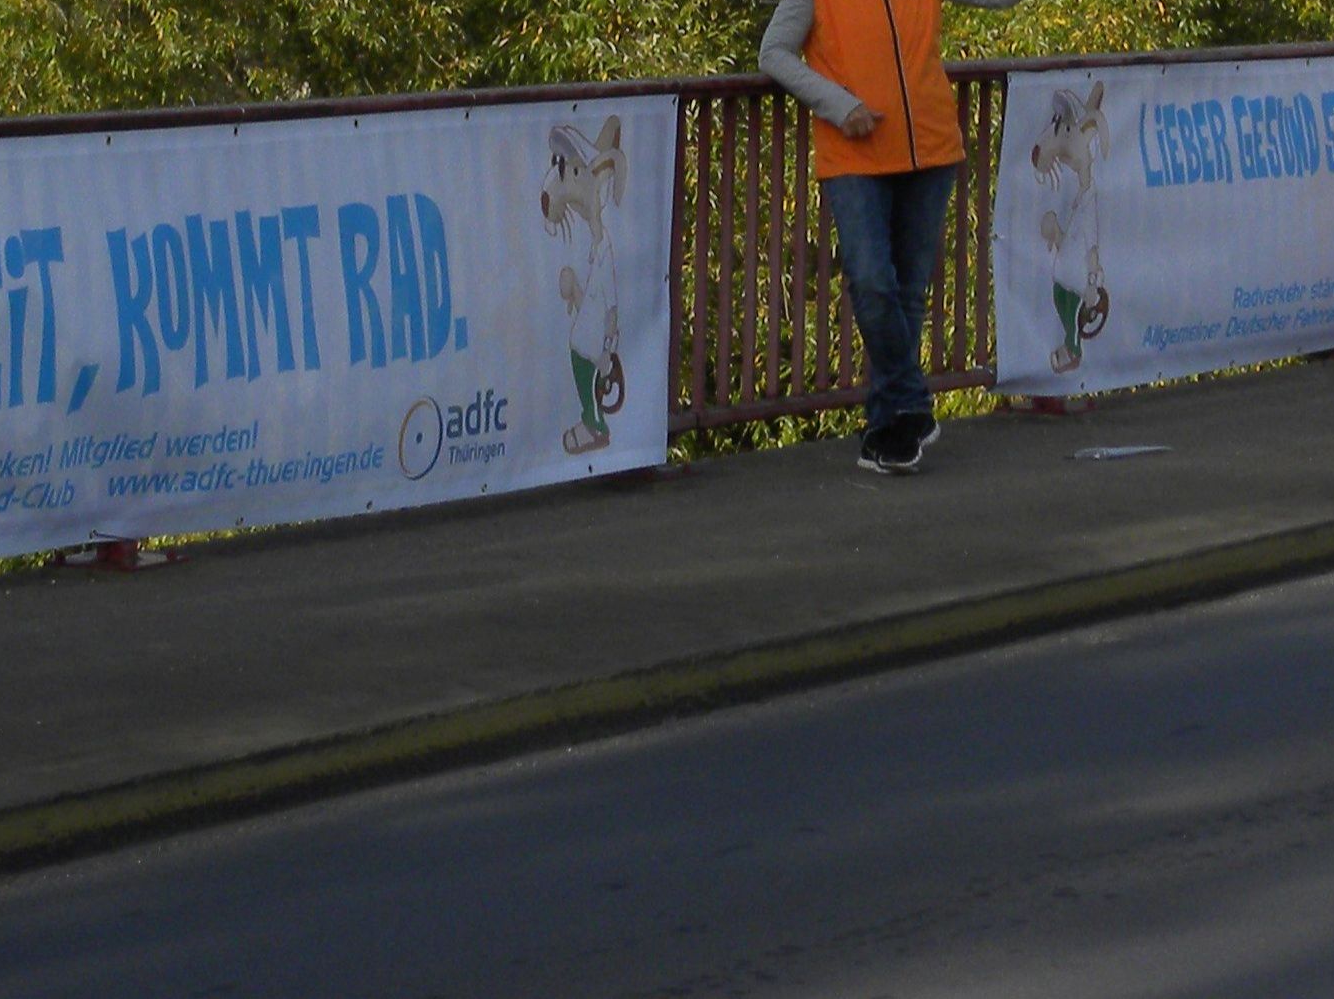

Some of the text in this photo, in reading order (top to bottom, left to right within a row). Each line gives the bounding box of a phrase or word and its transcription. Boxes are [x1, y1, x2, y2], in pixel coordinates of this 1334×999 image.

[1231, 93, 1321, 181] GESUND
[106, 204, 321, 398] KOMMT
[337, 192, 467, 369] RAD.
[446, 392, 509, 438] adfc
[60, 433, 158, 470] Mitglied
[166, 420, 258, 455] werden!
[108, 443, 384, 499] www.adfc-thueringen.de
[448, 440, 506, 467] Thüringen
